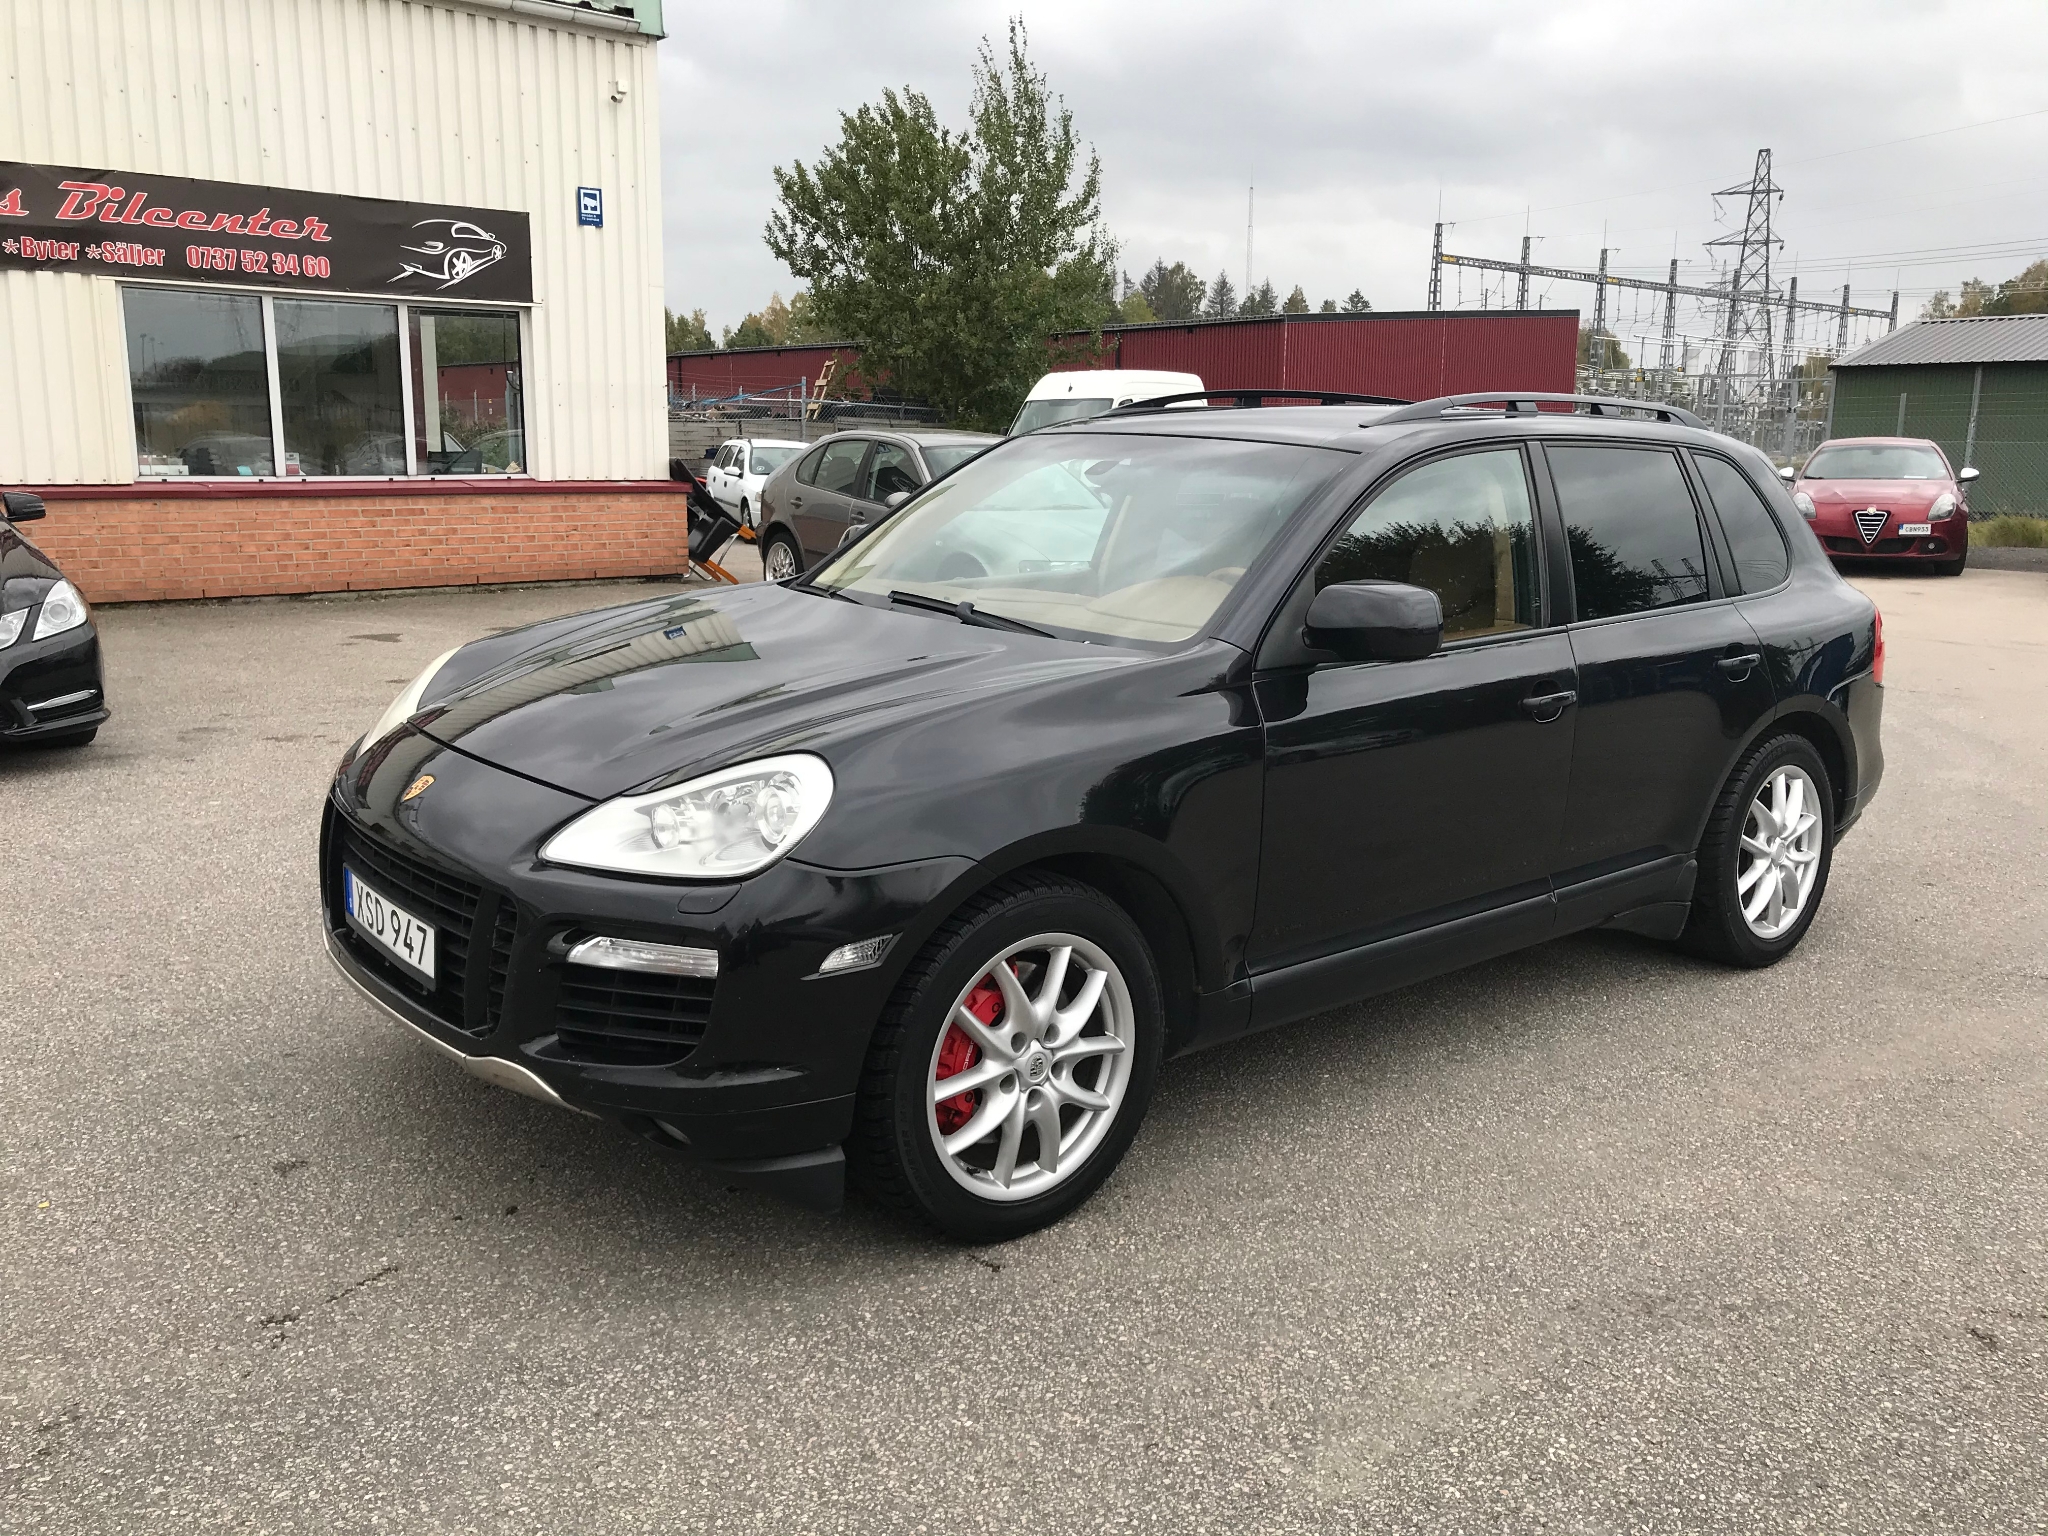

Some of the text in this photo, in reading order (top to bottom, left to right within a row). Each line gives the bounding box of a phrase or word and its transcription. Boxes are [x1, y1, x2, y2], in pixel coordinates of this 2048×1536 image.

[55, 181, 332, 241] Bilcenter
[186, 245, 237, 271] 0737
[241, 250, 268, 273] 52
[272, 252, 300, 276] 34
[303, 255, 330, 278] 60
[355, 881, 427, 966] XSD 947
